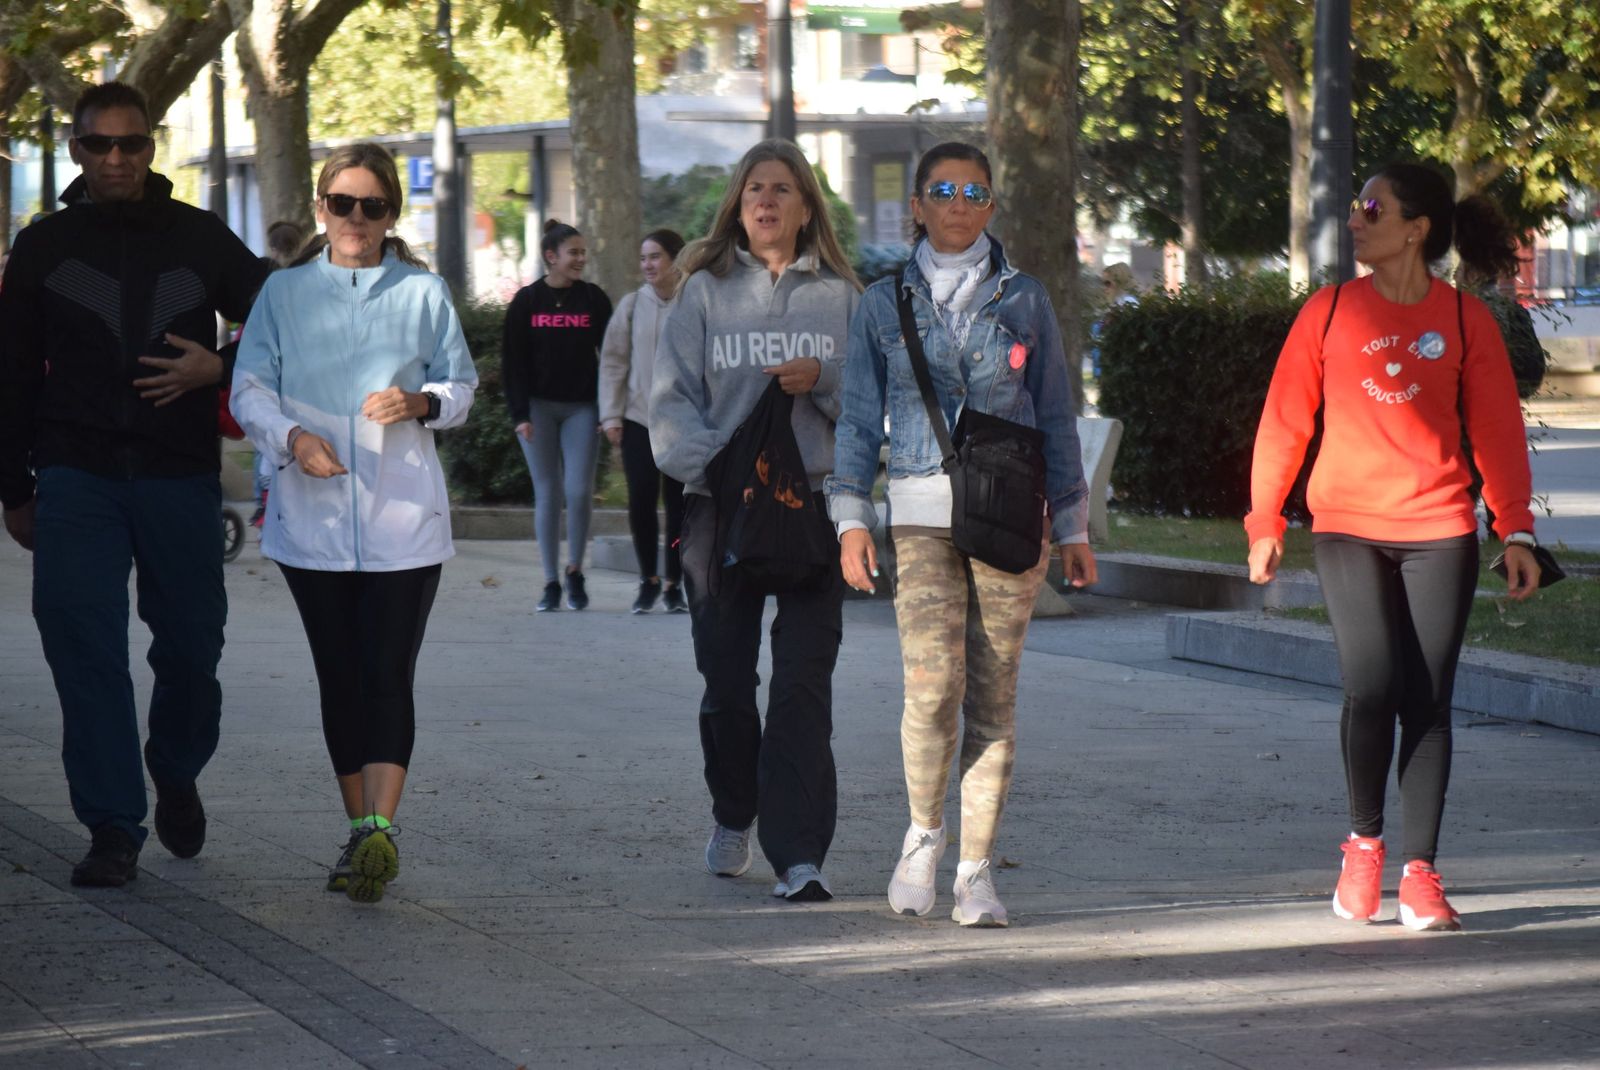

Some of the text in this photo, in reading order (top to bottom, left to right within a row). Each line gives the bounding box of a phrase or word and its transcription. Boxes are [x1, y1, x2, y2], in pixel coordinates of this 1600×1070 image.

[531, 314, 591, 328] IRENE
[712, 331, 835, 372] AU REVOIR
[1361, 335, 1423, 360] TOUT E
[1361, 378, 1422, 404] DOUCEUR
